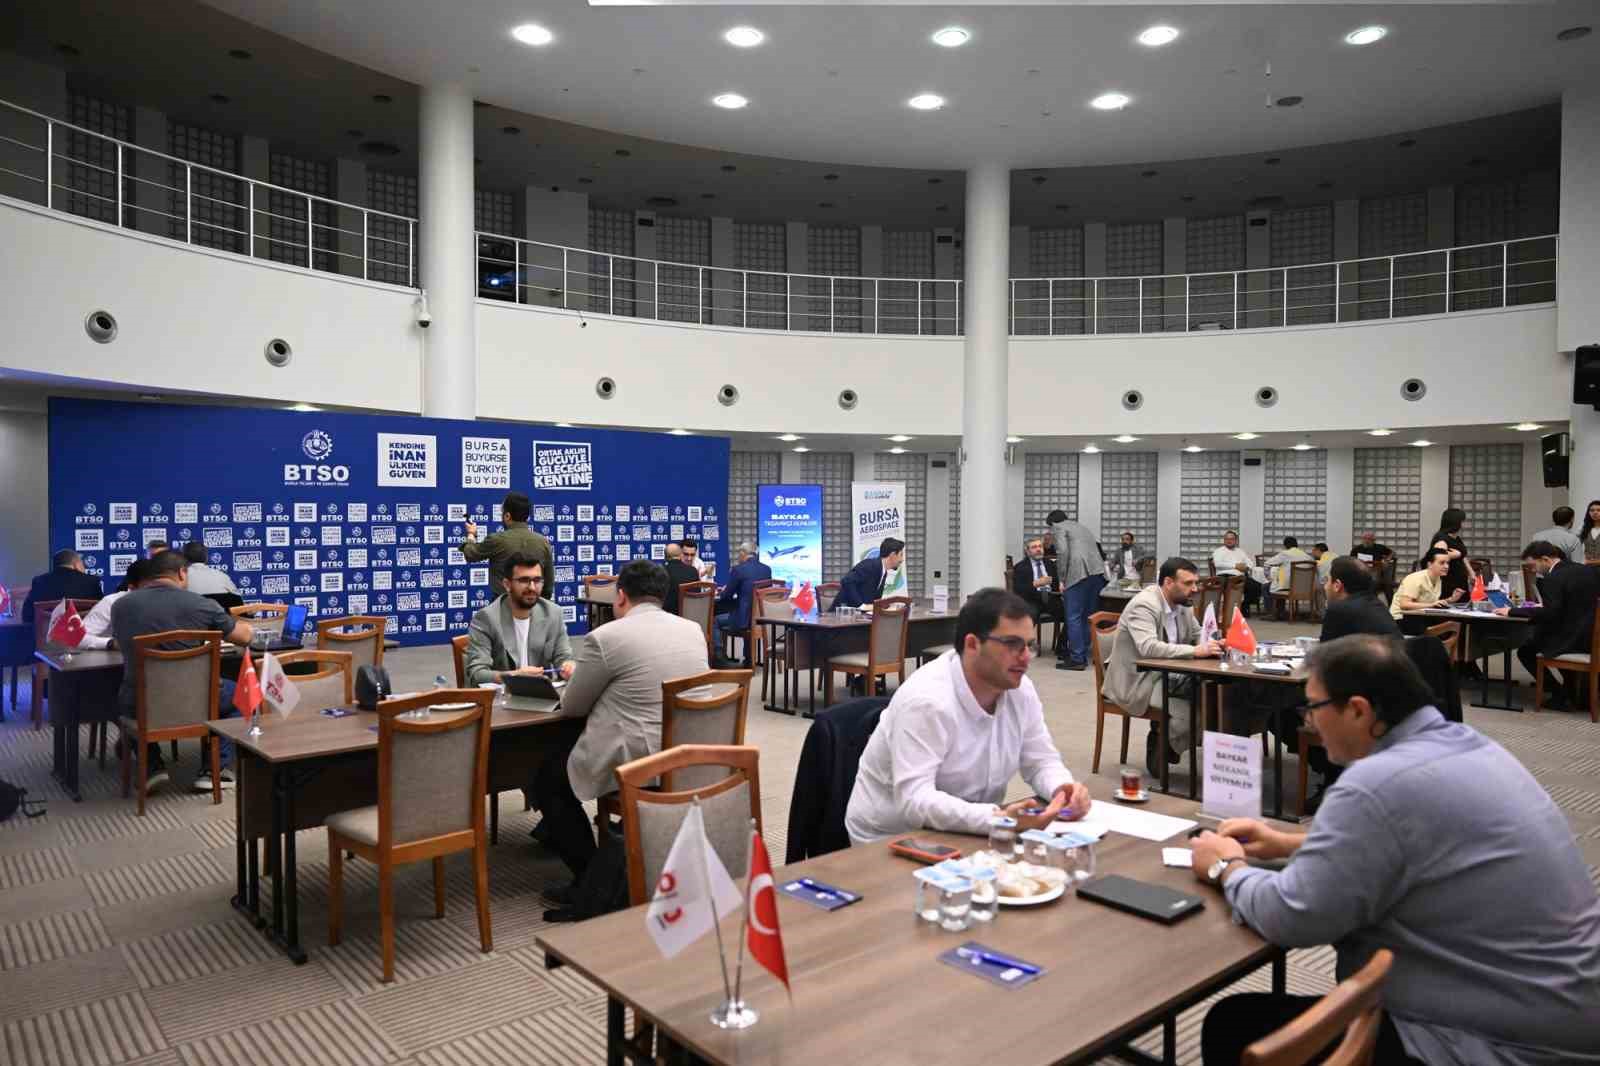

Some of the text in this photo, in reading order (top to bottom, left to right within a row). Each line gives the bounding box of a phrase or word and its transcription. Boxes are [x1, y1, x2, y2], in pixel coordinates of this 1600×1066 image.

[465, 441, 507, 451] BURSA
[538, 449, 563, 457] ORTAK
[284, 464, 349, 482] BTSO
[75, 515, 104, 524] BTSO
[859, 507, 900, 526] BURSA
[859, 520, 900, 534] AEROSPACE
[396, 580, 416, 589] BTSO
[1215, 751, 1248, 763] BAYKAR
